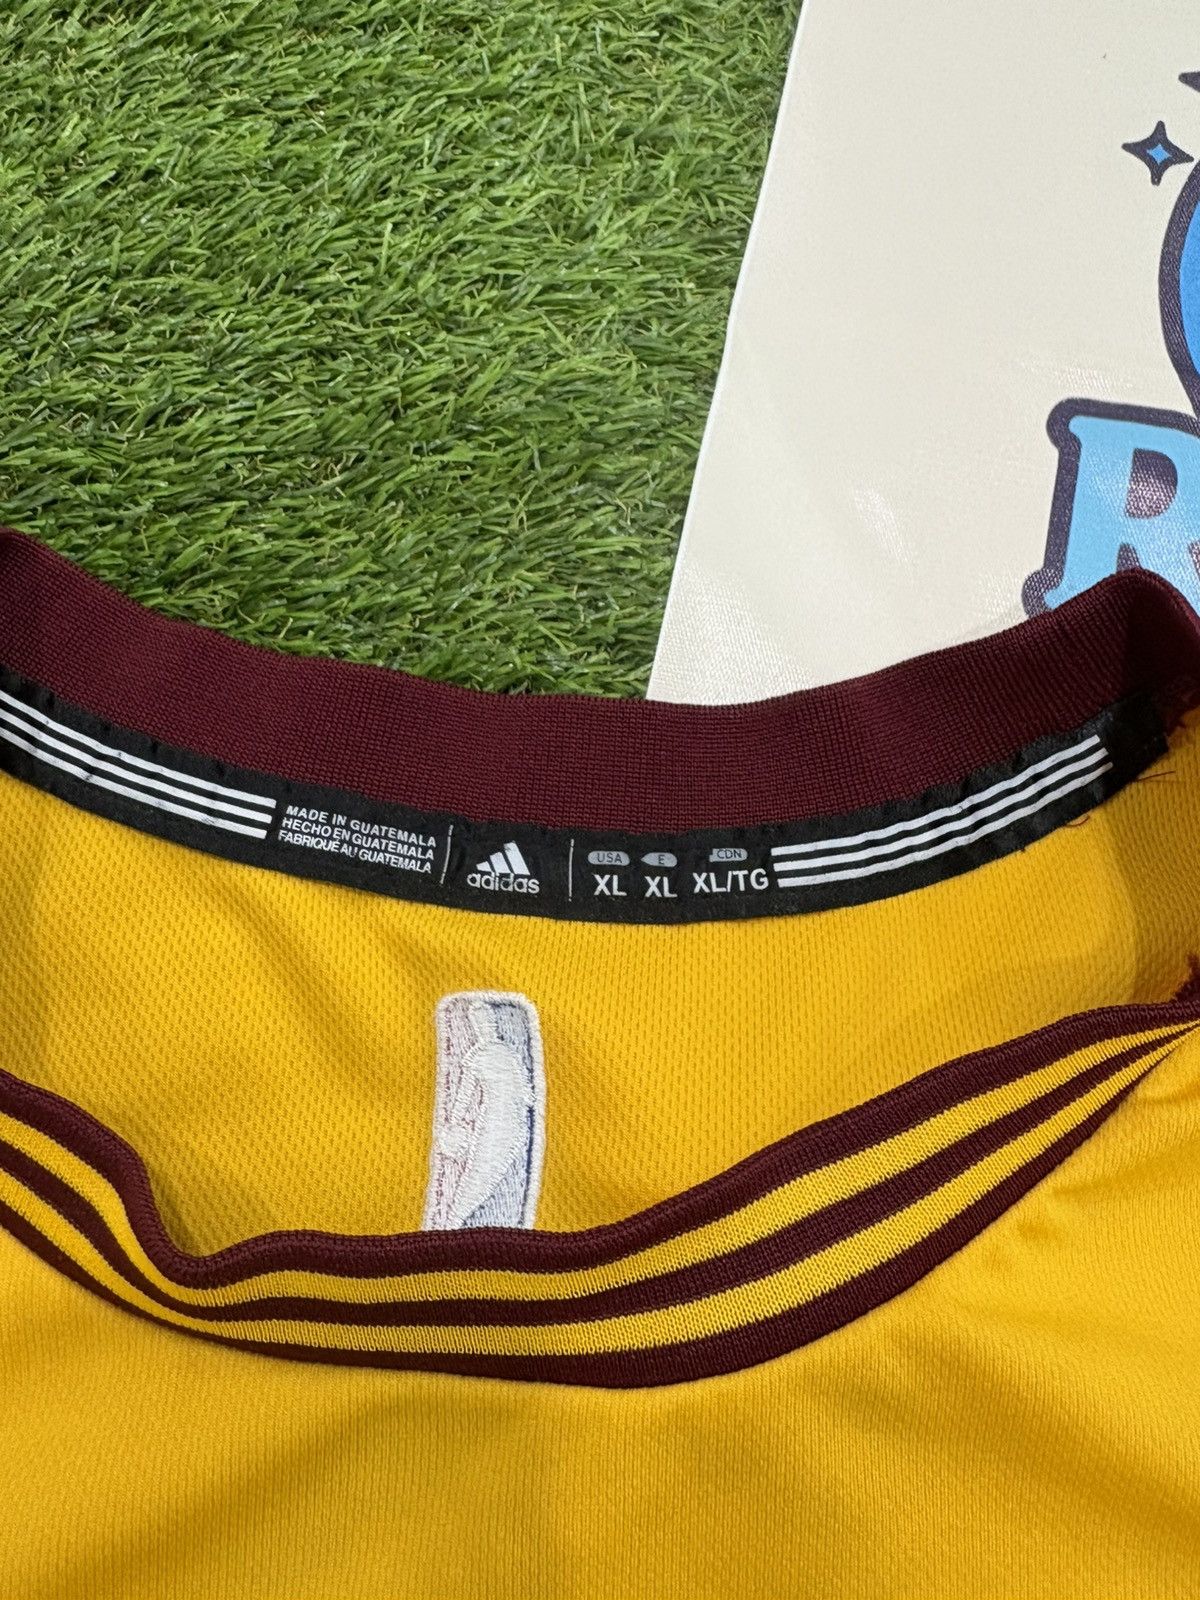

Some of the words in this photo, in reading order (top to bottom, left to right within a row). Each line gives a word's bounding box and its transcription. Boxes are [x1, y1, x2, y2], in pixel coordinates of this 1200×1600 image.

[281, 817, 330, 838] HECHO
[333, 827, 350, 842] EN
[351, 834, 434, 861] GUATEMALA
[286, 805, 329, 824] MADE
[332, 813, 347, 827] IN
[350, 819, 436, 848] GUATEMALA
[277, 829, 339, 853] FABRIQUÉ
[358, 851, 432, 874] GUATEMALA
[596, 852, 623, 864] USA
[657, 852, 666, 865] E
[716, 848, 743, 860] CDN
[466, 872, 540, 894] adidas
[593, 873, 627, 897] XL
[644, 875, 678, 898] XL
[692, 867, 770, 894] XL/TG
